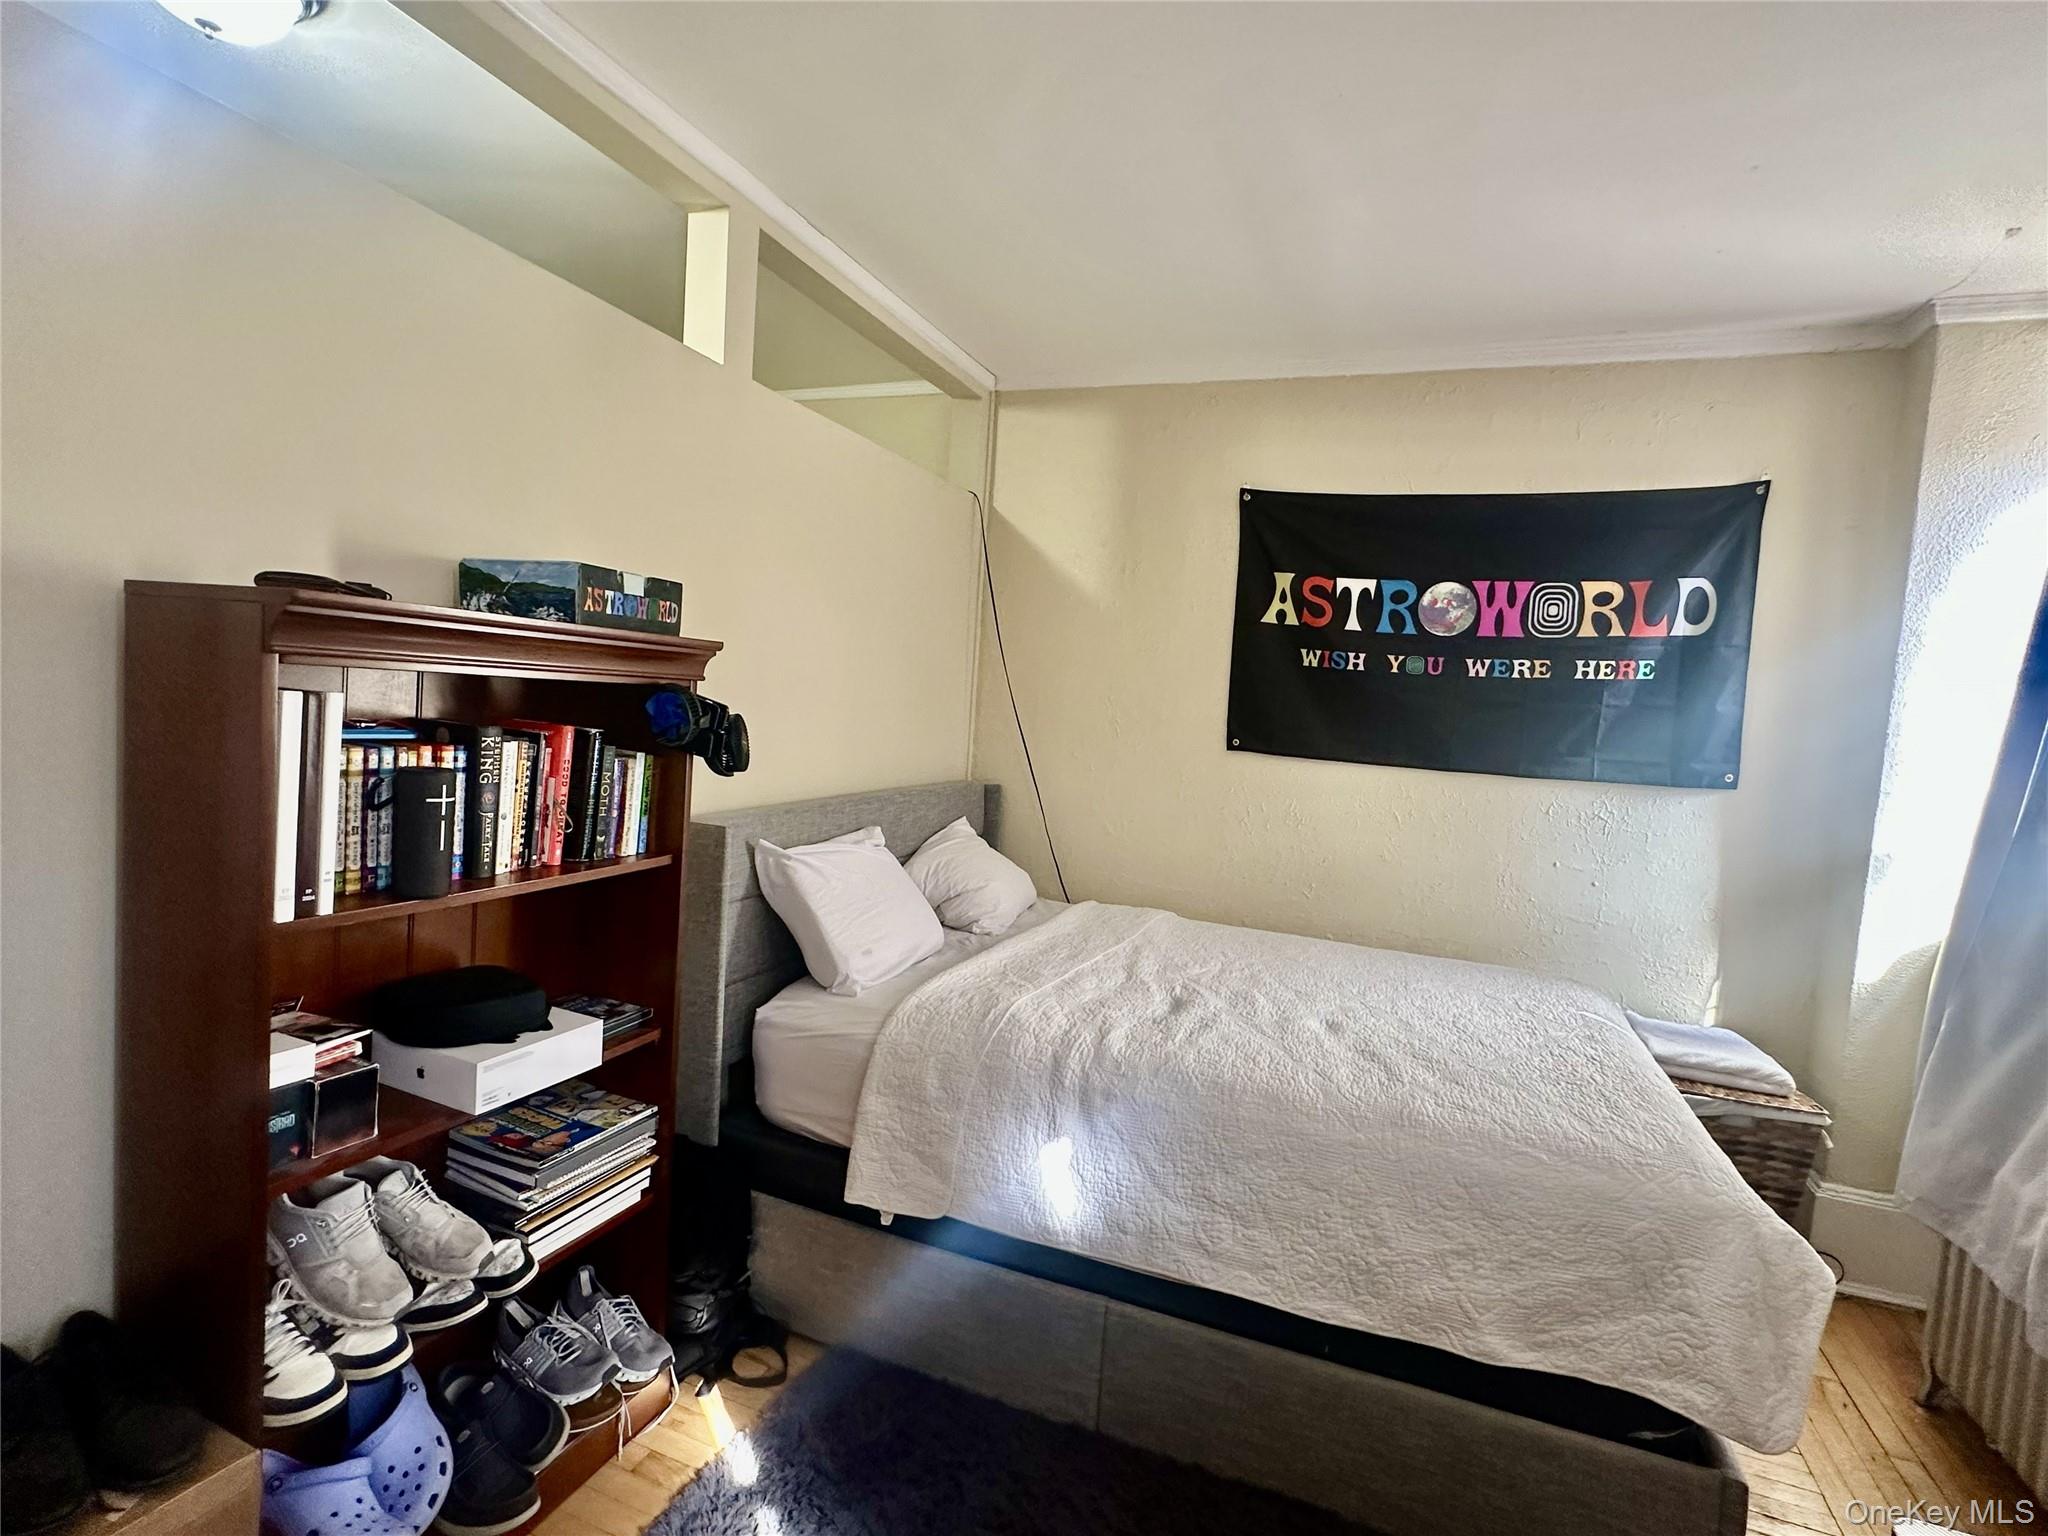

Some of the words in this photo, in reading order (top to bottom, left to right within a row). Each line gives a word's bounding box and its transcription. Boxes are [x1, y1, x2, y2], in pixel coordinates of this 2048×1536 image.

[1259, 571, 1719, 639] ASTROWORLD
[1300, 647, 1367, 672] WISH
[1386, 653, 1445, 676] YOU
[1465, 657, 1552, 680] WERE
[1574, 658, 1656, 682] HERE
[479, 736, 494, 784] KING
[494, 736, 502, 784] STEPHEN
[561, 759, 571, 787] GOOD
[598, 771, 612, 817] MOTH
[478, 810, 495, 838] FAIRY
[481, 842, 493, 863] TALE
